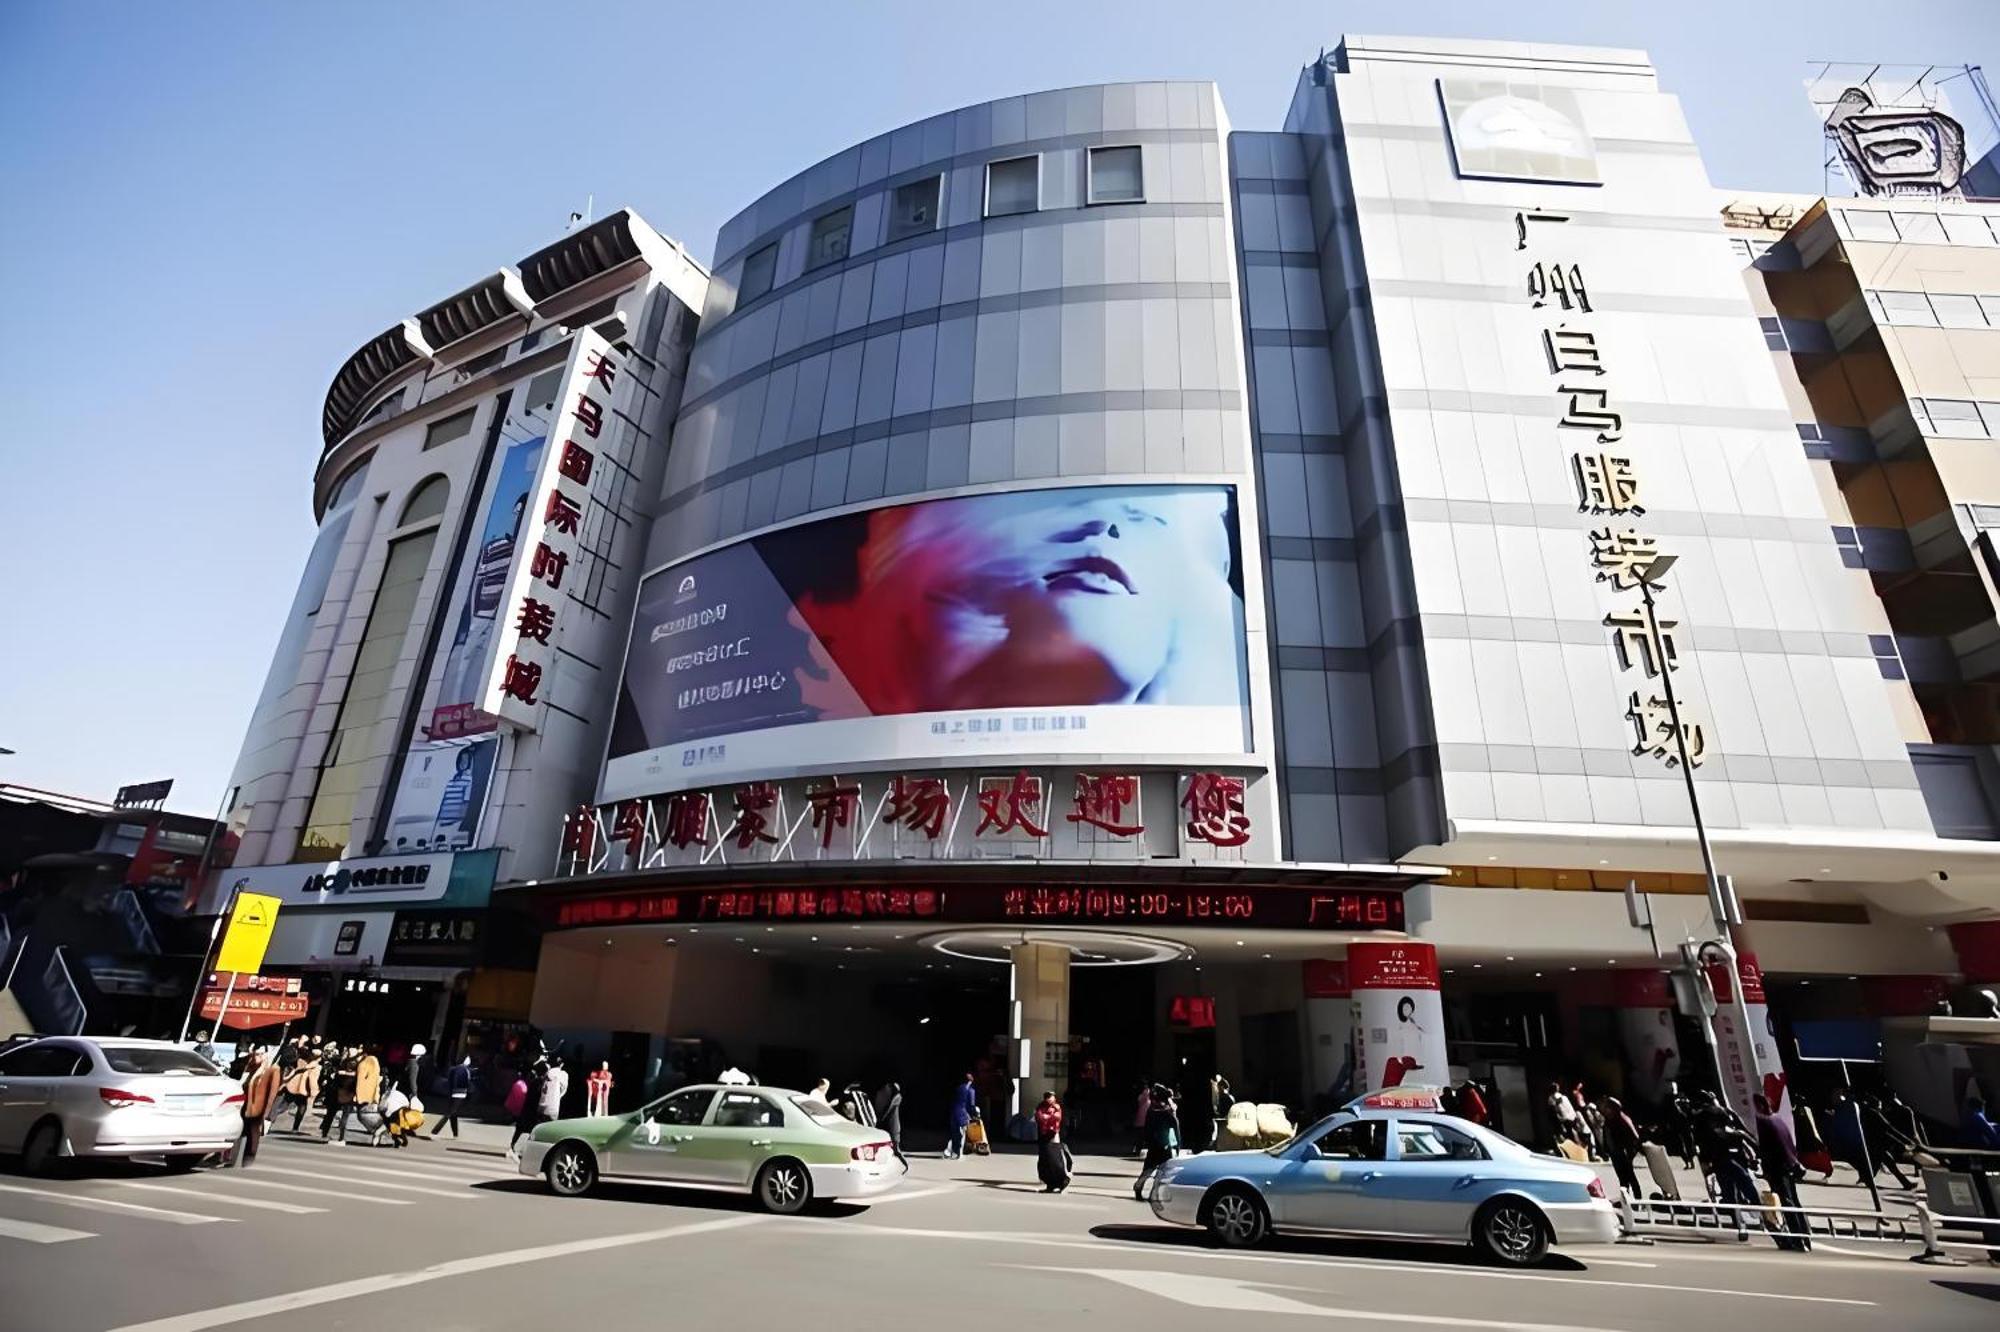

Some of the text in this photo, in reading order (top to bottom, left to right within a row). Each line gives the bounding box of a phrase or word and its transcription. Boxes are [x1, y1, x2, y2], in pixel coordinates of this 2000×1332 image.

[500, 349, 617, 705] 天马国际时装城
